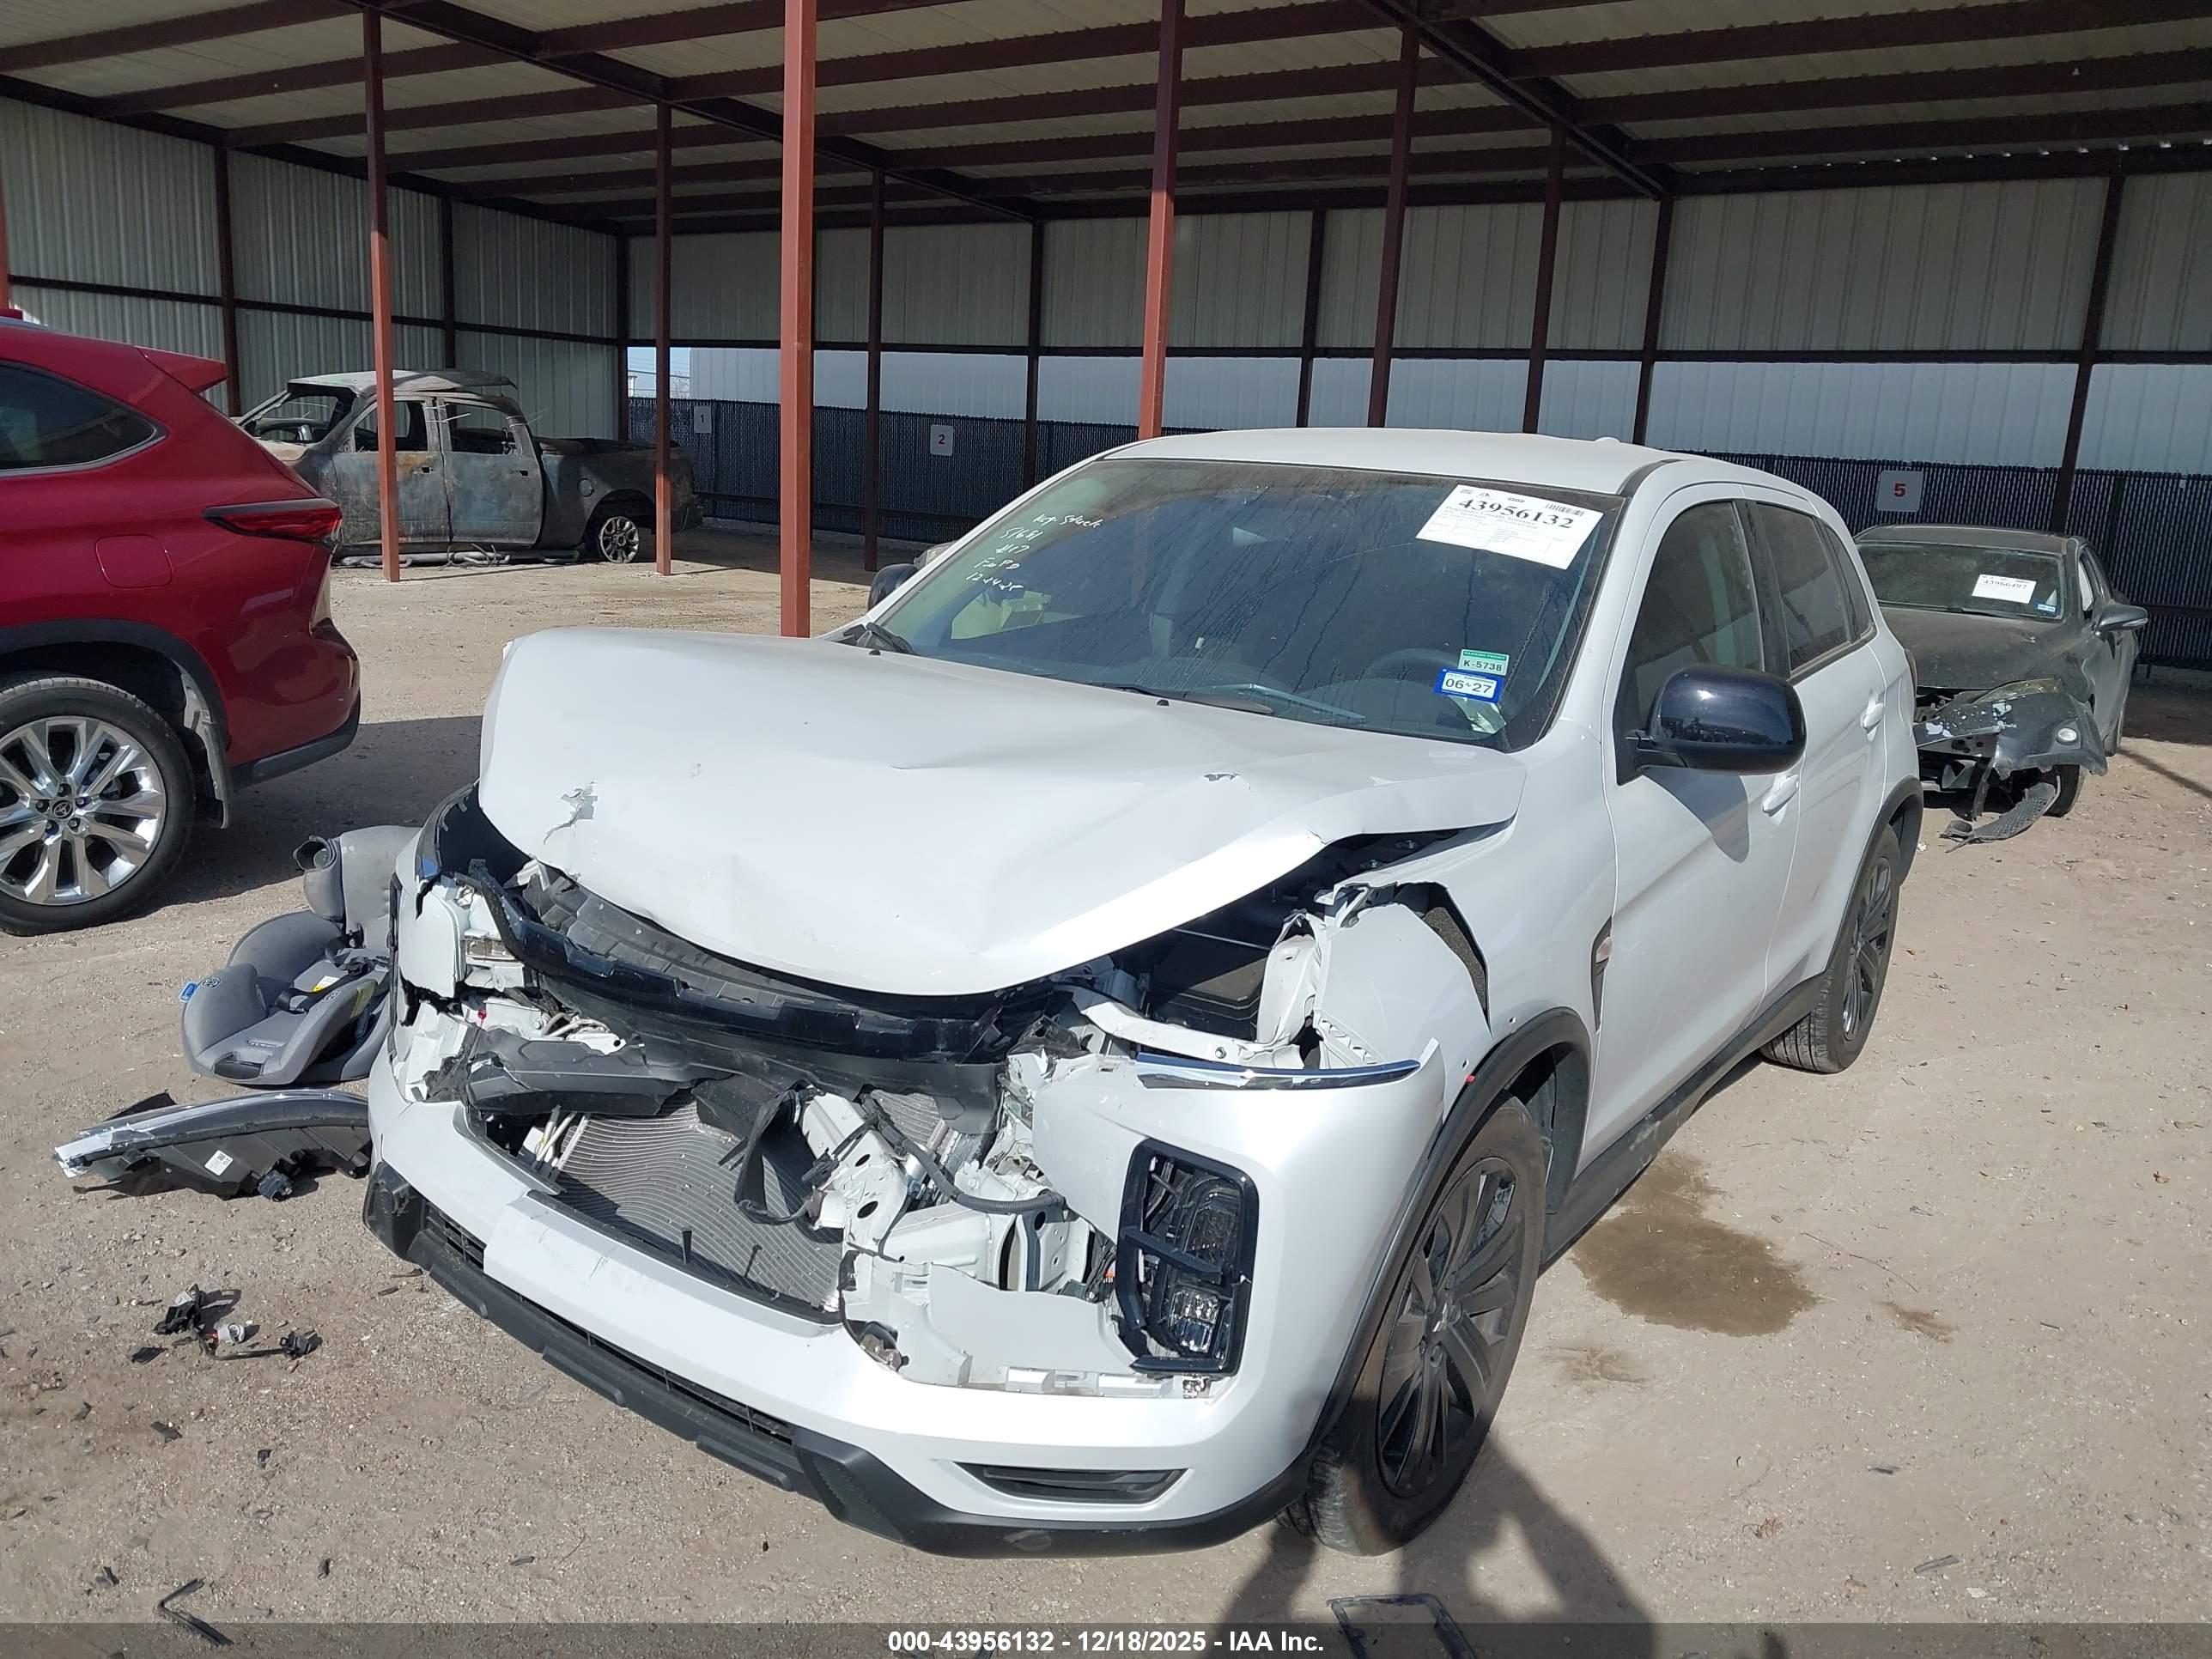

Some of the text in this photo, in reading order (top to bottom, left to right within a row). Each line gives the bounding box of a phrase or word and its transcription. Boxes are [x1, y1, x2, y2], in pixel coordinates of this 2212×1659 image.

[938, 433, 946, 445] 2
[1893, 483, 1906, 498] 5
[1458, 498, 1575, 529] 43956132
[1462, 659, 1503, 672] K-5738
